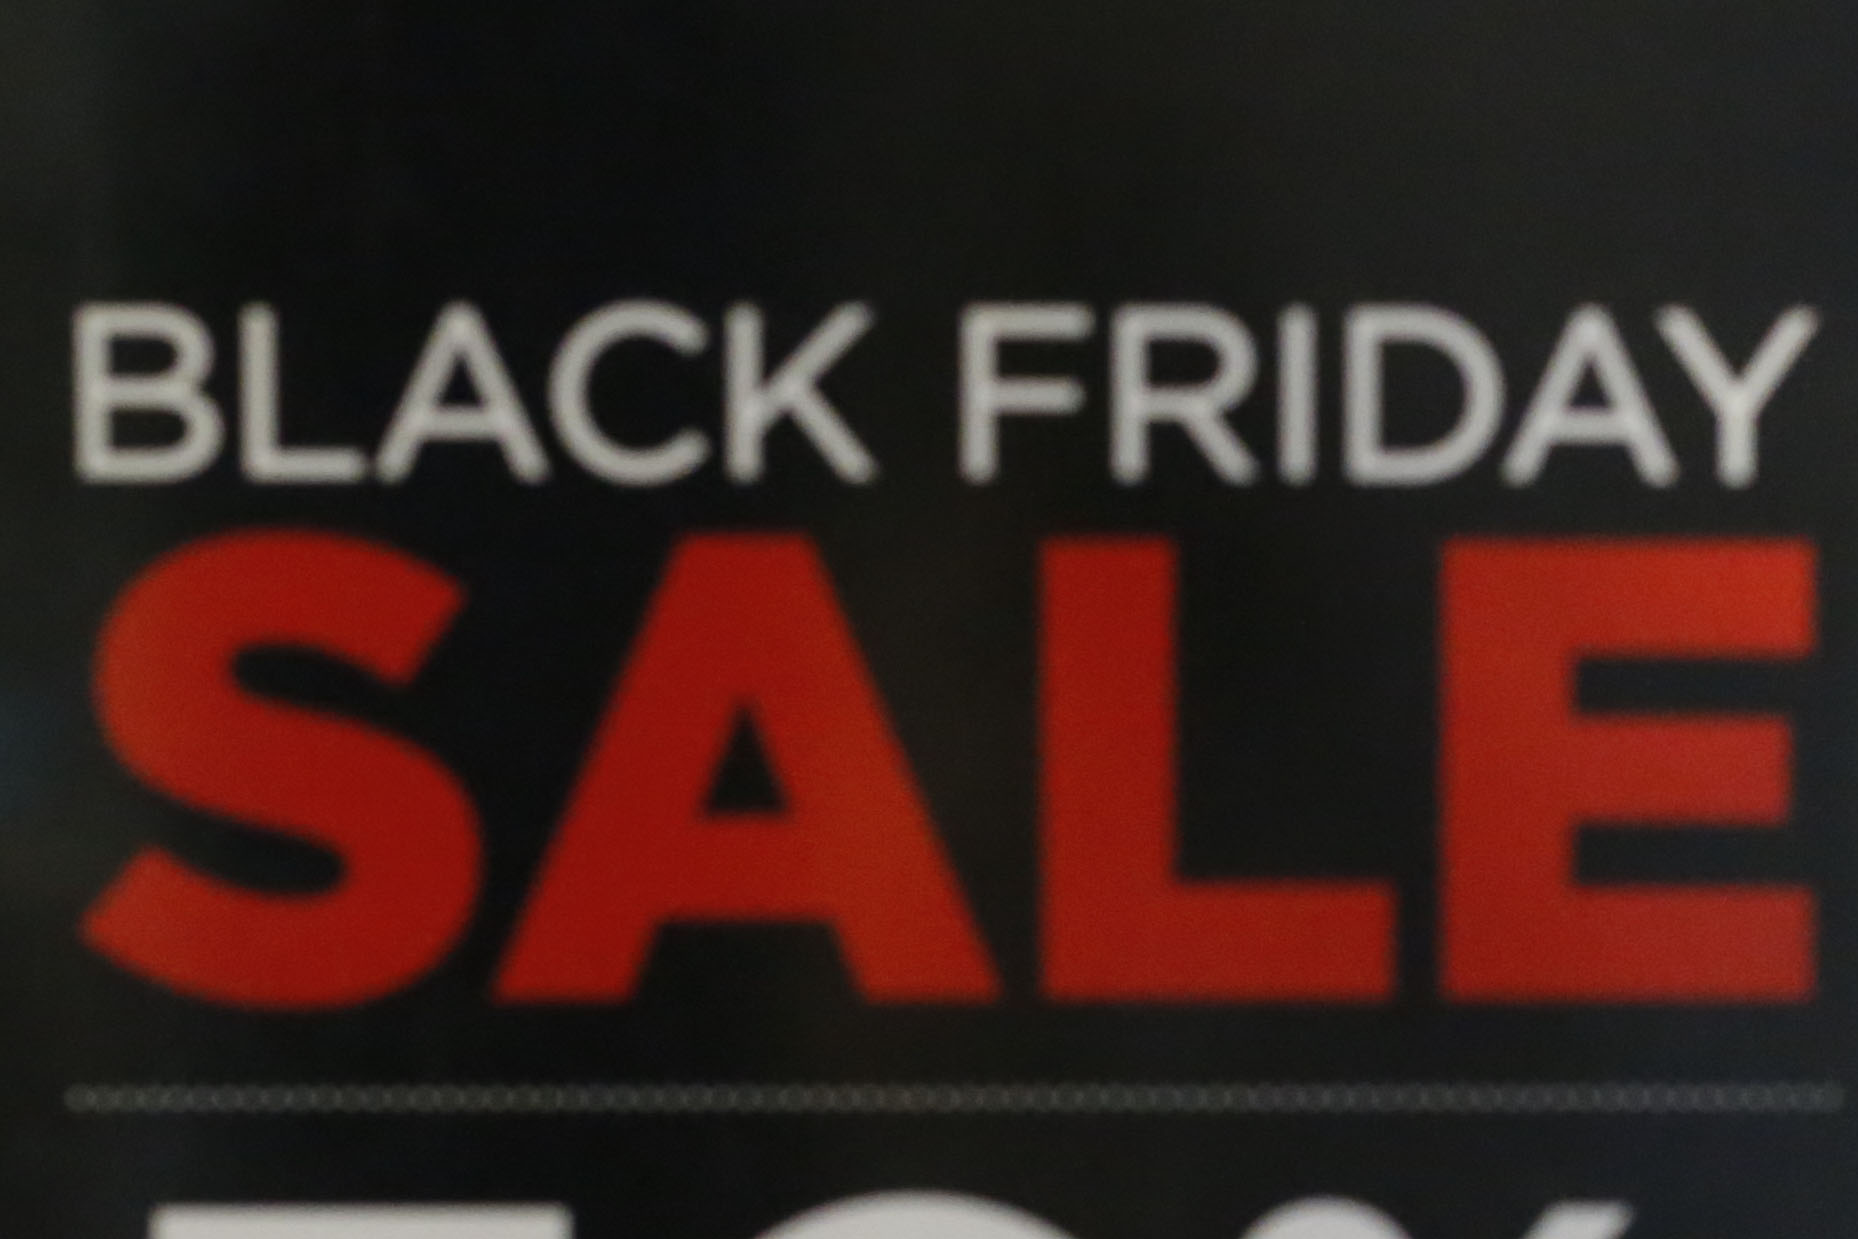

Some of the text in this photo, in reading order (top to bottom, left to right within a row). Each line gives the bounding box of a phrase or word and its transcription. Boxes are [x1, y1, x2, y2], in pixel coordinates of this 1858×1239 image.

[73, 302, 1817, 487] BLACK FRIDAY
[84, 532, 1817, 1005] SALE
